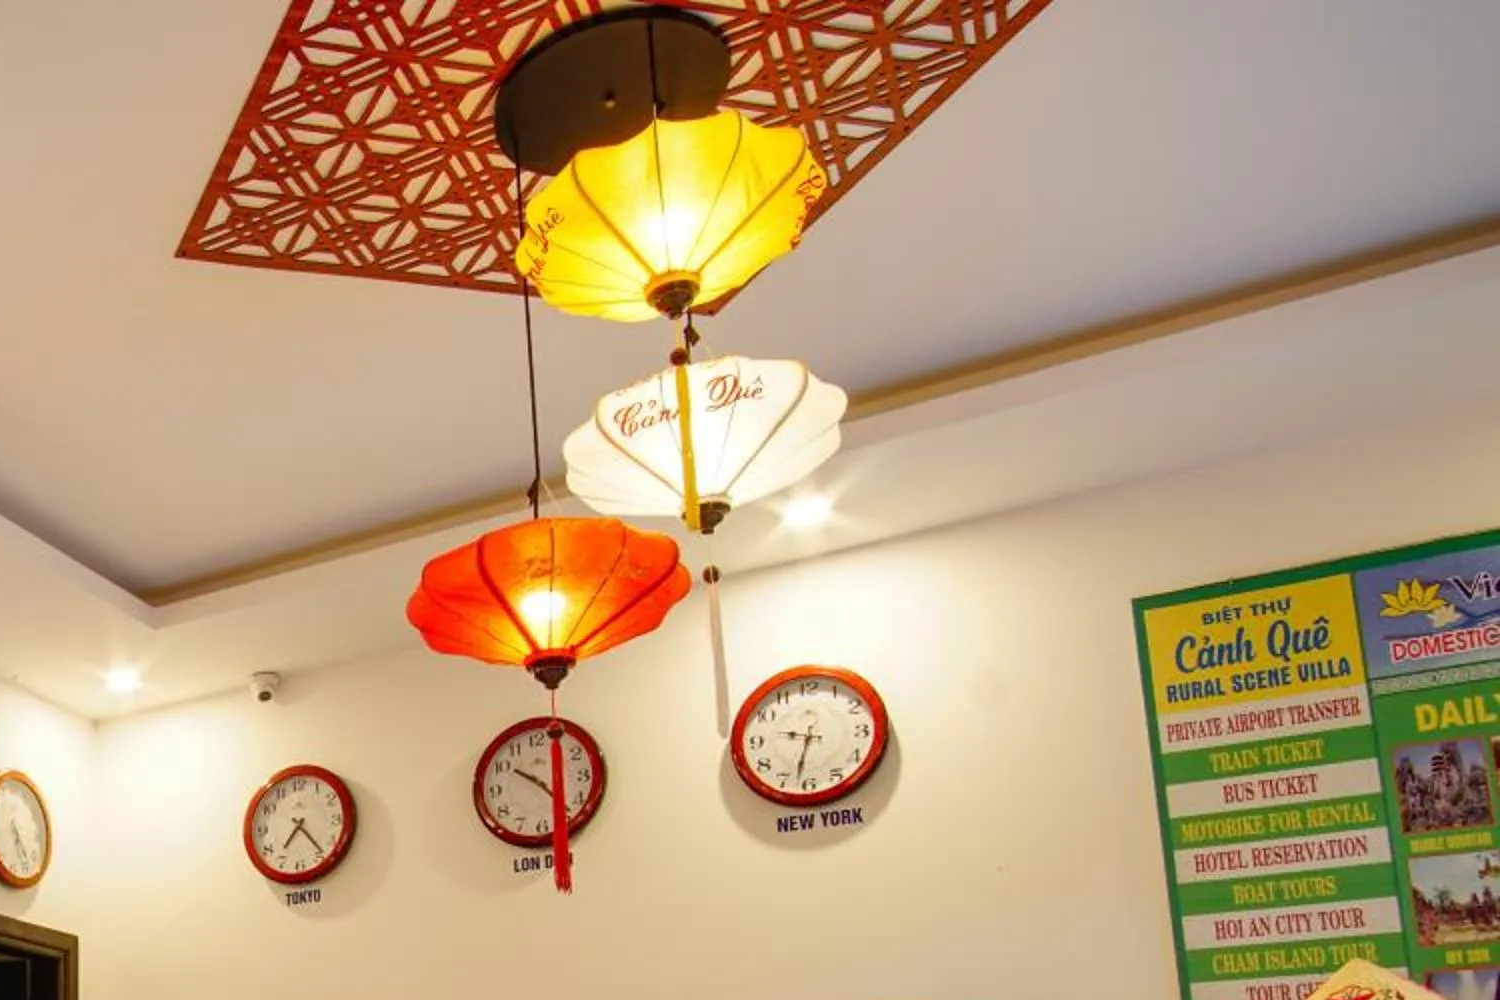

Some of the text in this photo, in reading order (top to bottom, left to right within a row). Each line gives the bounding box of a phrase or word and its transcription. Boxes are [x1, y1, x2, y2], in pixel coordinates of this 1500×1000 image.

[613, 399, 680, 438] Cản
[1175, 616, 1331, 673] Cảnh Quê
[800, 680, 819, 696] 12
[1166, 679, 1226, 703] RURAL
[1232, 665, 1290, 693] SCENE
[1298, 656, 1351, 682] VILLA
[848, 700, 861, 715] 2
[1166, 696, 1361, 743] PRIVATE AIRPORT TRANSFER
[529, 732, 545, 747] 12
[854, 724, 870, 738] 3
[509, 743, 522, 757] 11
[749, 736, 765, 749] 9
[570, 747, 583, 761] 2
[1210, 738, 1324, 773] TRAIN TICKET
[494, 760, 511, 774] 10
[757, 757, 771, 772] 8
[577, 768, 590, 782] 3
[489, 784, 503, 799] 9
[802, 777, 817, 791] 6
[1223, 773, 1318, 804] BUS TICKET
[777, 808, 864, 832] NEW YORK
[1181, 814, 1264, 843] MOTOBIKE
[1268, 811, 1303, 832] FOR
[1194, 835, 1369, 873] HOTEL RESERVATION
[286, 890, 321, 907] TOKYO
[1233, 876, 1338, 904] BOAT TOURS
[1214, 907, 1366, 940] HOI AN CITY TOUR
[1212, 951, 1262, 974] CHAM
[1264, 946, 1326, 971] ISLAND
